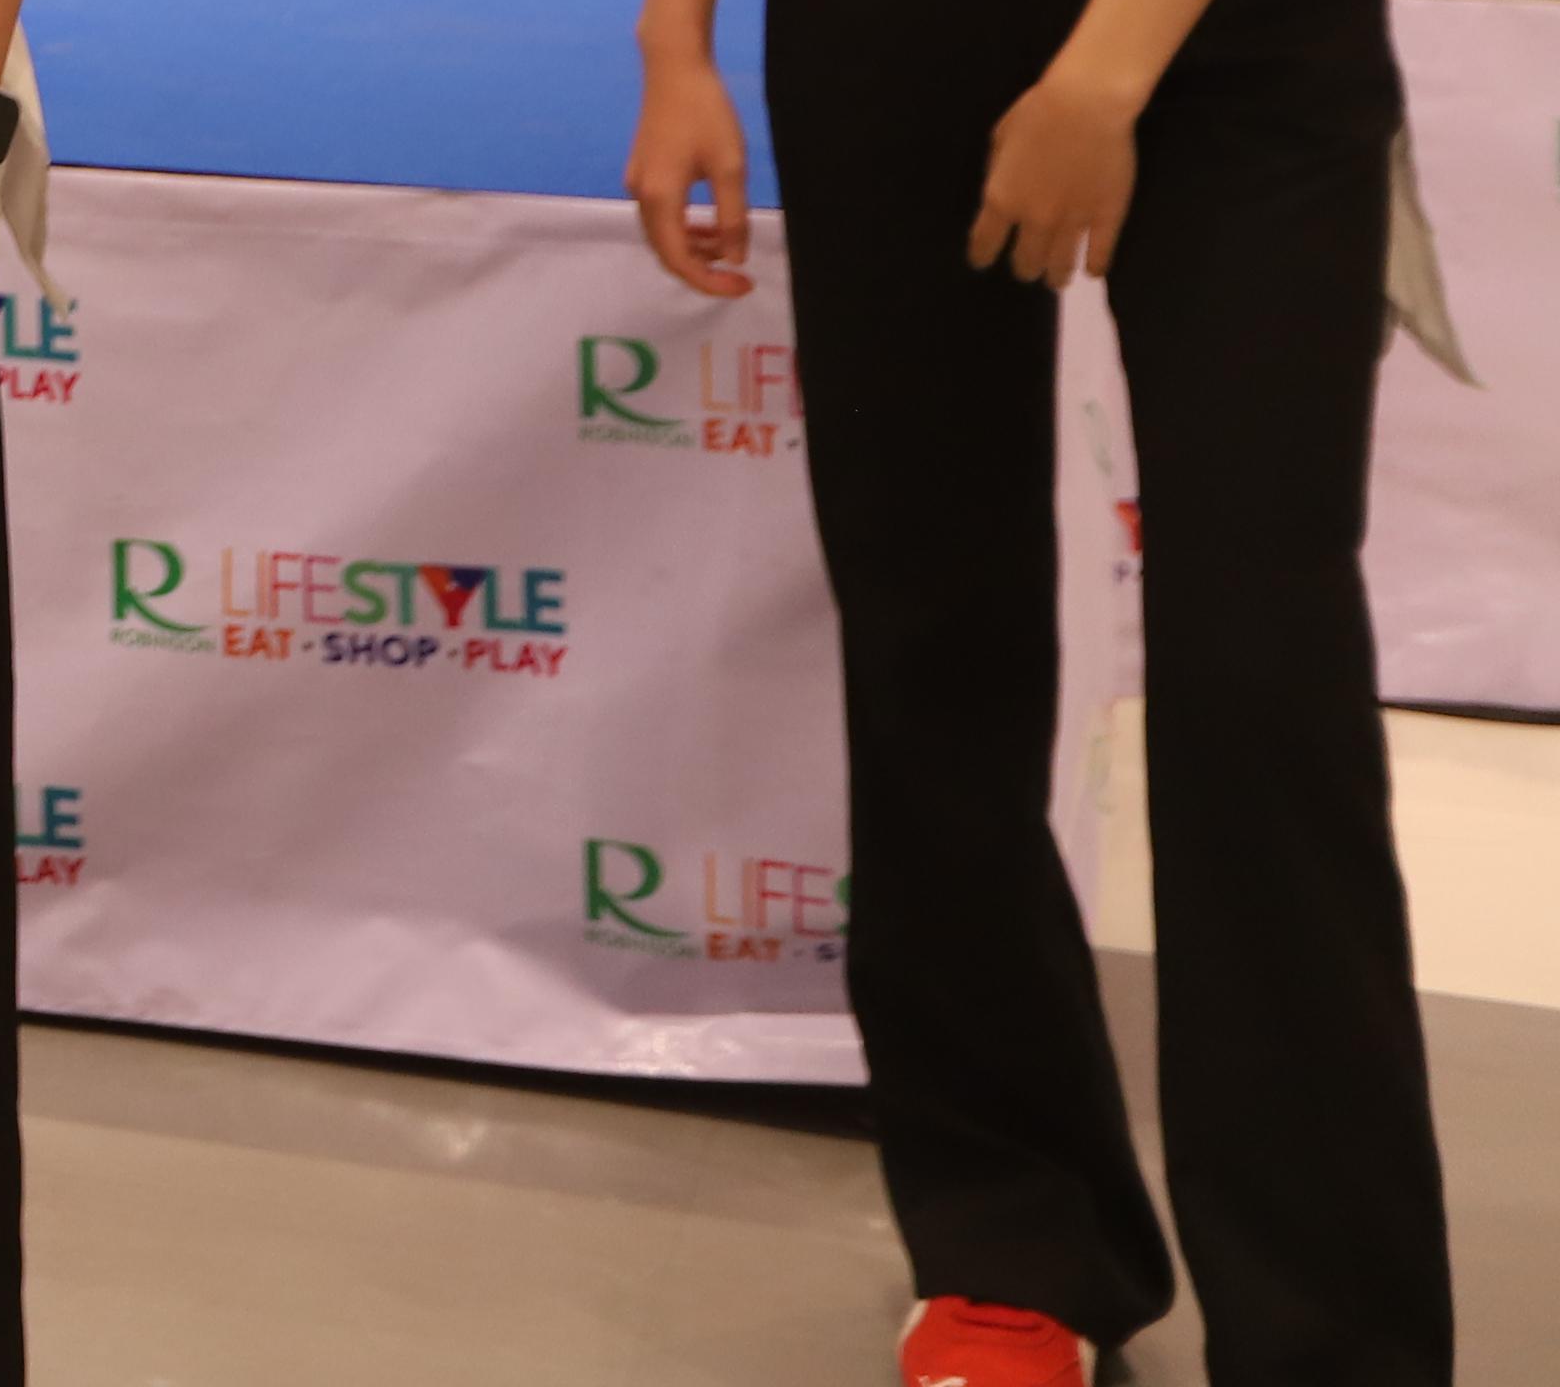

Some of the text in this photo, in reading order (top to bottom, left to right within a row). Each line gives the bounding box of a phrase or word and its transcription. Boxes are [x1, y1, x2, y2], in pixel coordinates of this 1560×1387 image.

[580, 337, 686, 427] R
[701, 419, 780, 458] EAT
[111, 538, 567, 635] R LIFESTYLE
[222, 625, 295, 660] EAT
[321, 632, 438, 667] SHOP
[462, 638, 567, 677] PLAY
[585, 838, 689, 938] R
[705, 931, 782, 962] EAT
